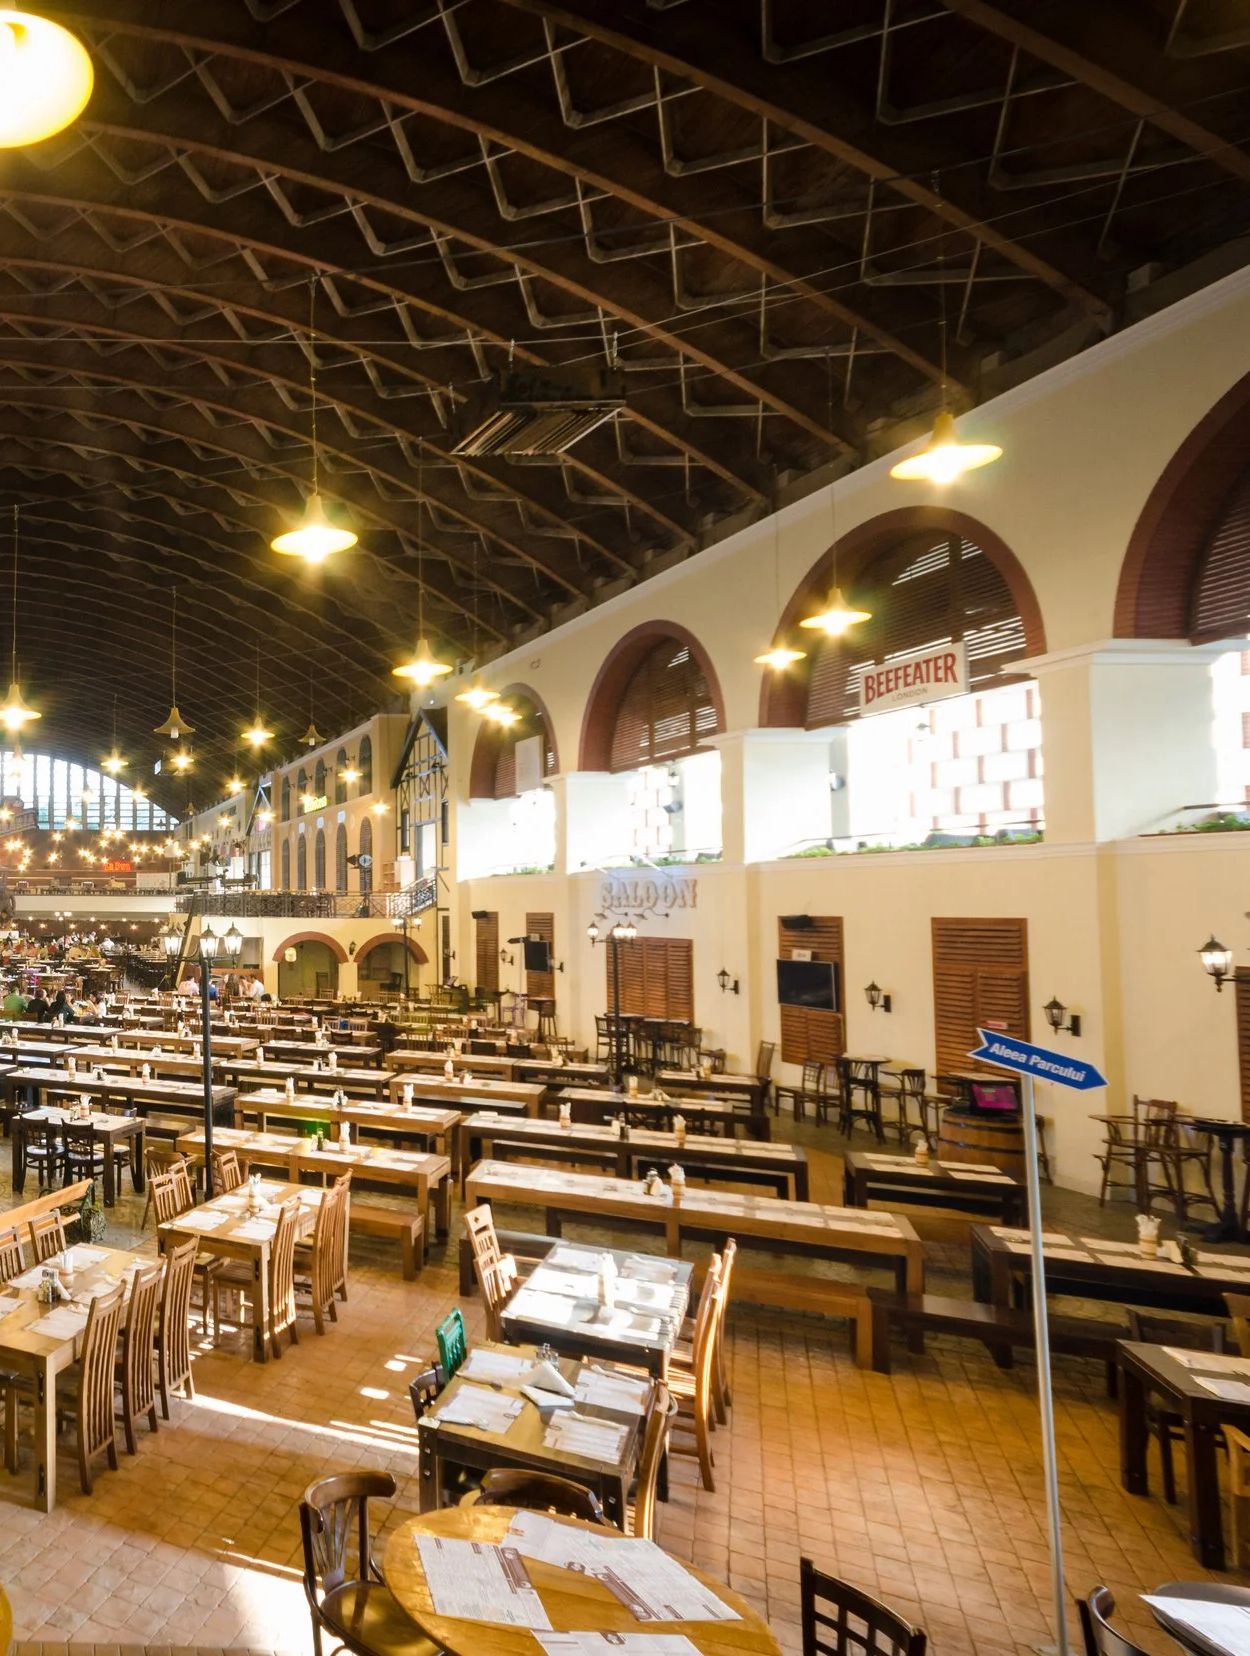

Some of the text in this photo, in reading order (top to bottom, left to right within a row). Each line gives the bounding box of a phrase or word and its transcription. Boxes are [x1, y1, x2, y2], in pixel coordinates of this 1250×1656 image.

[864, 652, 958, 705] BEEFEATER
[892, 687, 928, 702] LONDON
[601, 879, 697, 909] SALOON
[989, 1042, 1087, 1083] Aleea Parcului
